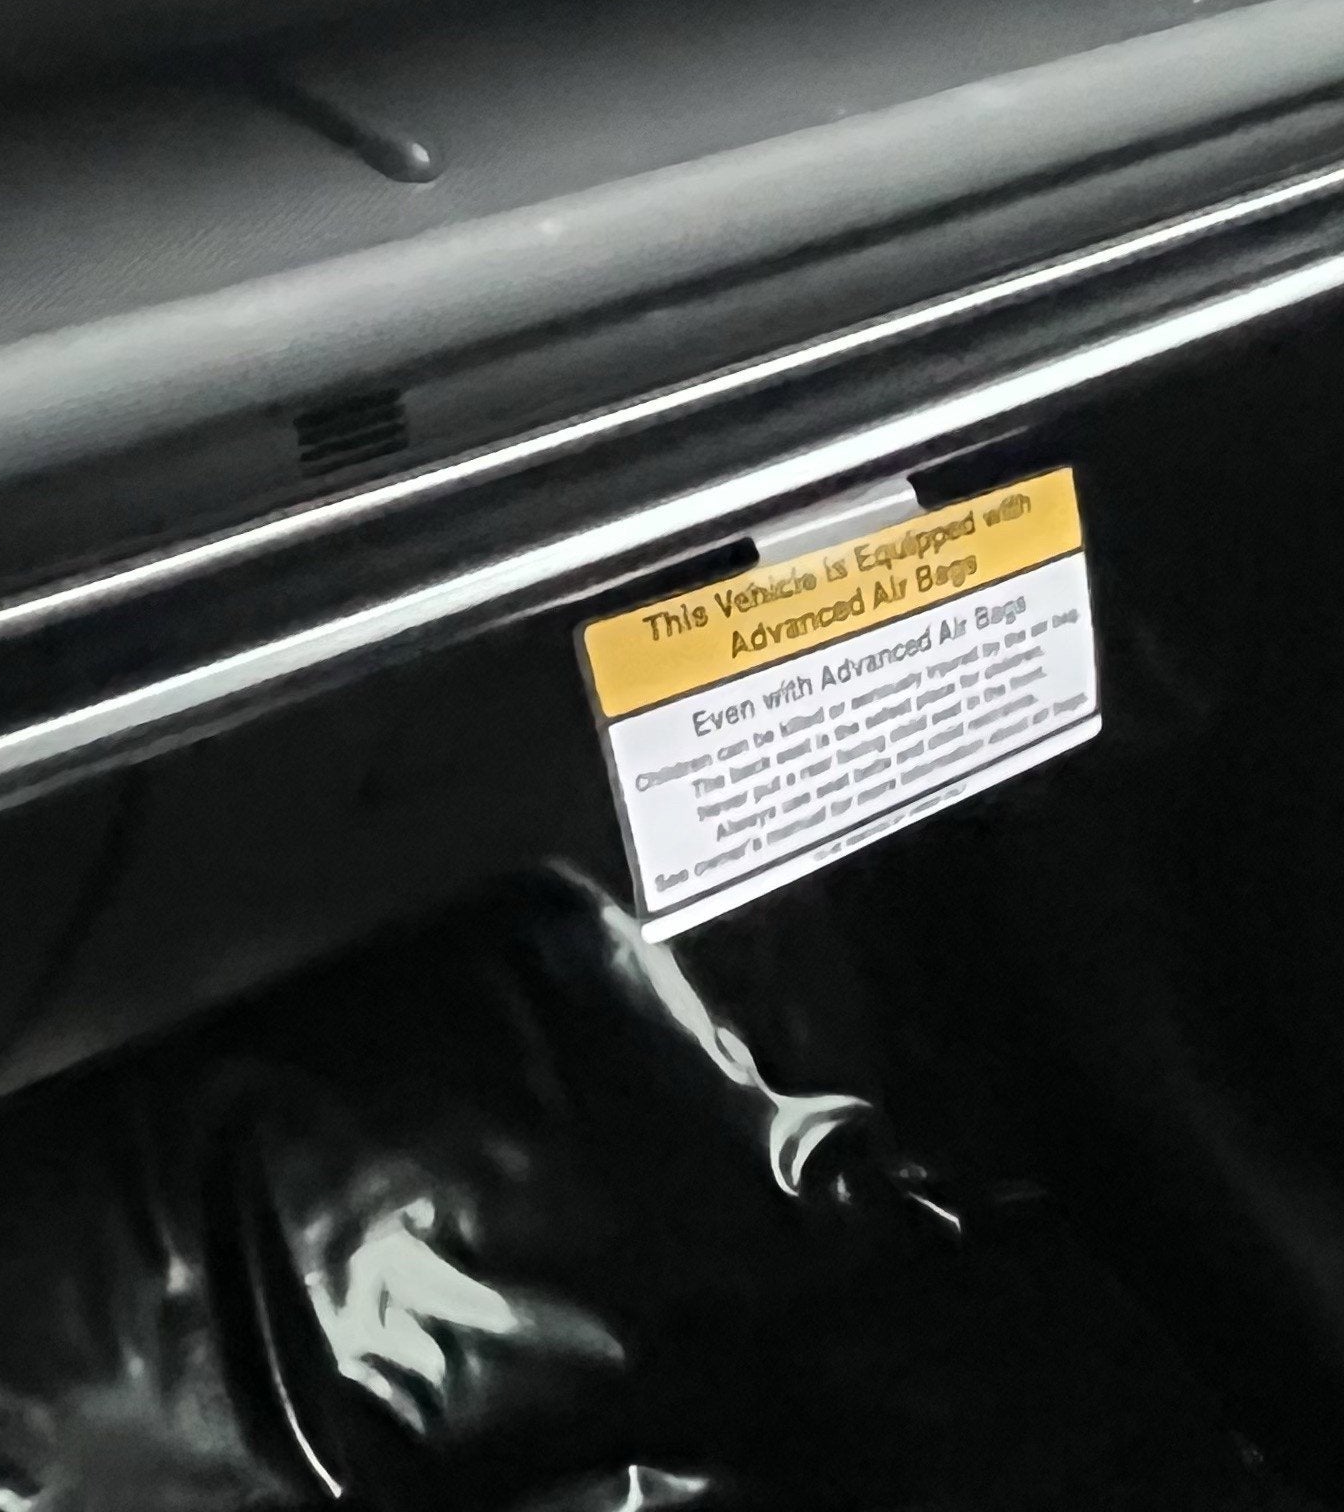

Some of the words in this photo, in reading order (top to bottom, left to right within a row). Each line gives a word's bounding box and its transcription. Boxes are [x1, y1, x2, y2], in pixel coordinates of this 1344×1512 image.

[642, 603, 709, 641] This
[714, 566, 818, 619] Vehicle
[823, 556, 848, 582] is
[854, 510, 976, 571] Equipped
[983, 493, 1032, 527] with
[732, 586, 865, 659] Advanced
[873, 575, 908, 610] Air
[916, 555, 978, 593] Bags
[693, 699, 756, 737] Even
[763, 676, 813, 710] with
[821, 624, 932, 690] Advanced
[939, 617, 967, 645] Air
[975, 596, 1027, 630] Bags
